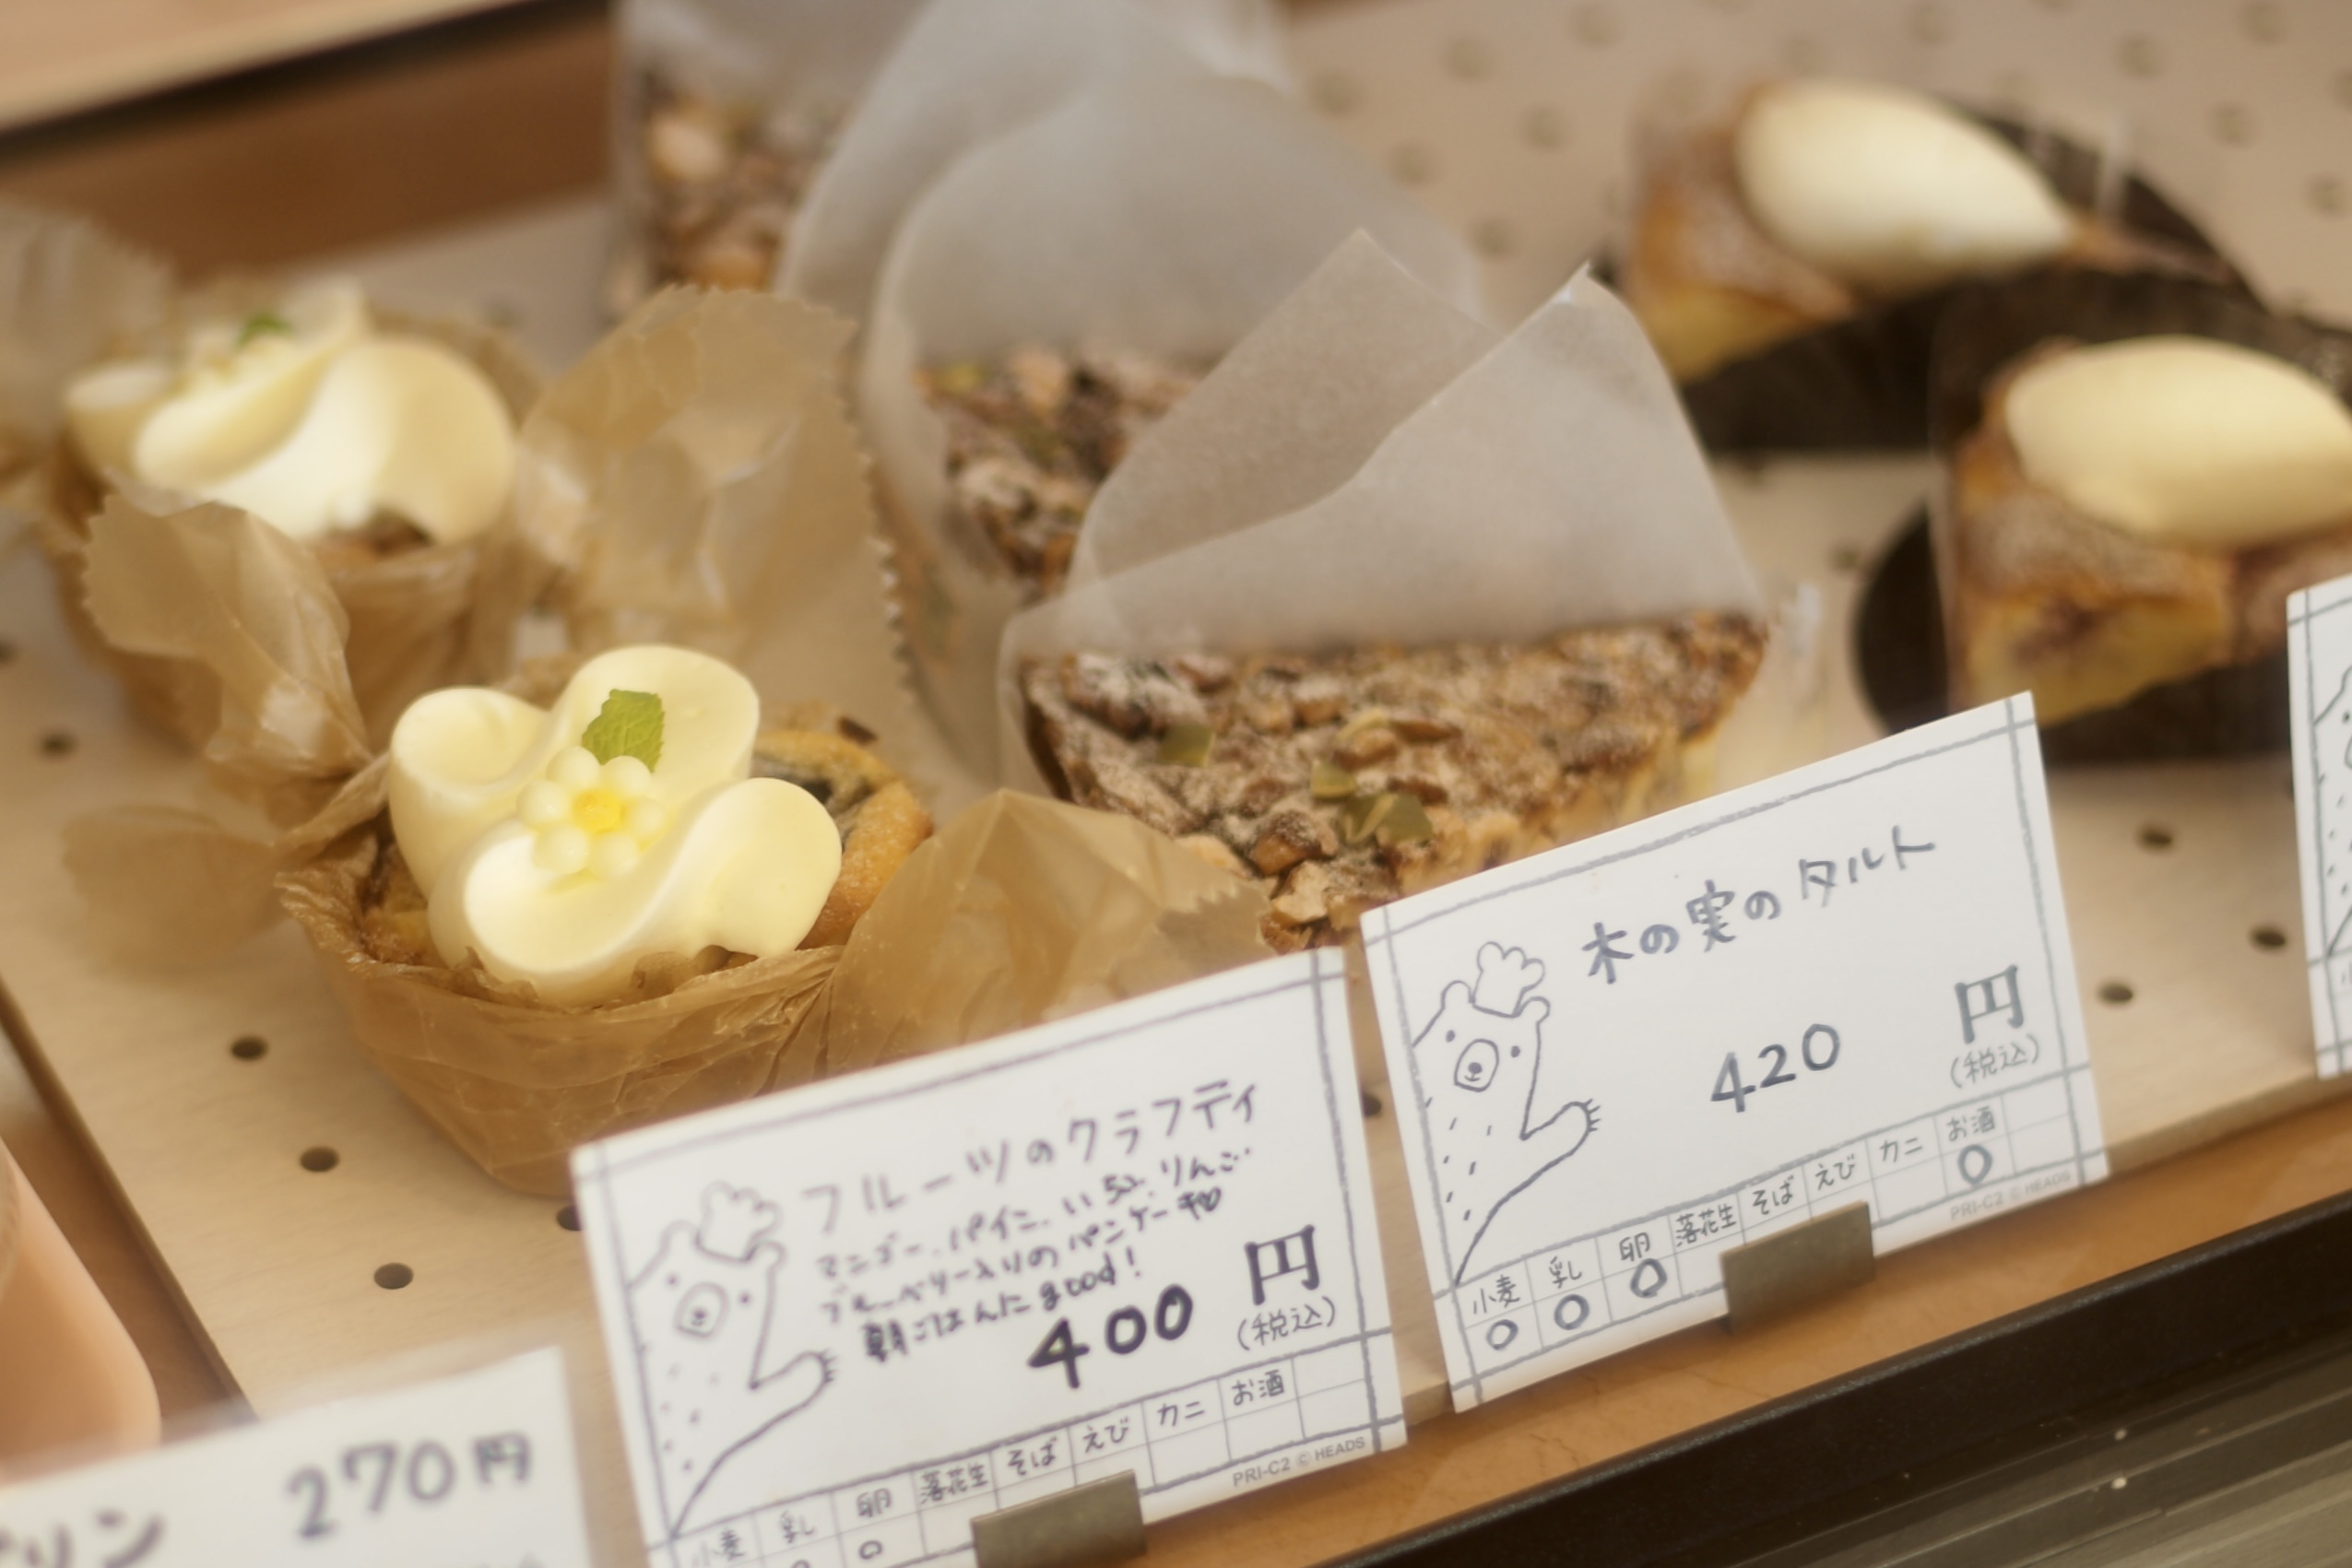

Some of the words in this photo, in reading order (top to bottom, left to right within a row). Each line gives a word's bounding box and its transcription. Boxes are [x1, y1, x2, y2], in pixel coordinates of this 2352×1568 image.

[1581, 825, 1935, 984] 木の実のタルト
[1954, 964, 2024, 1044] 円
[1710, 1023, 1840, 1113] 420
[802, 1079, 1256, 1233] フルーツのクラフティ
[2026, 1172, 2071, 1197] HEADS
[1473, 1274, 1520, 1314] 小麦
[1549, 1256, 1582, 1288] 乳
[1619, 1232, 1650, 1262] 卵
[1675, 1203, 1737, 1246] 落花生
[1752, 1174, 1794, 1216] そば
[1815, 1154, 1855, 1190] えび
[1879, 1138, 1922, 1162] カニ
[1947, 1106, 1995, 1142] お酒
[1245, 1224, 1319, 1305] 円
[1026, 1284, 1193, 1388] 400
[780, 1510, 814, 1543] 乳
[856, 1487, 892, 1517] 卵
[920, 1463, 988, 1504] 落花生
[1008, 1435, 1057, 1475] そば
[1083, 1418, 1129, 1453] えび
[1157, 1400, 1205, 1427] カニ
[1232, 1370, 1285, 1406] お酒
[1233, 1456, 1290, 1488] PRI-C2
[1315, 1436, 1366, 1462] HEADS
